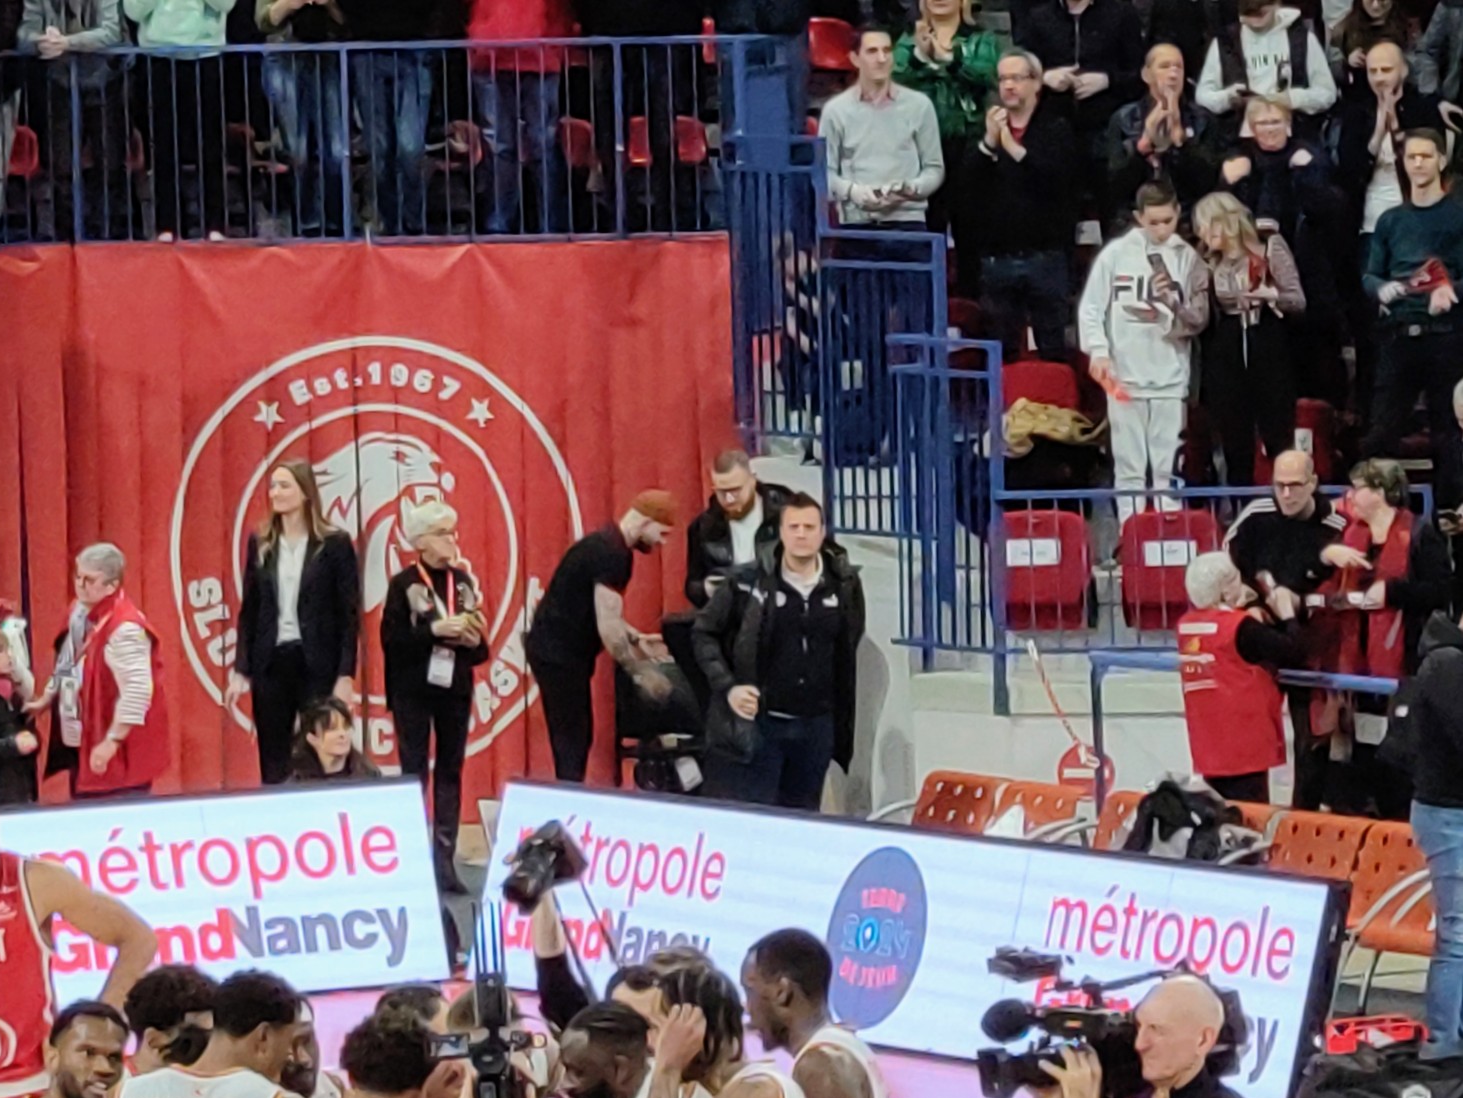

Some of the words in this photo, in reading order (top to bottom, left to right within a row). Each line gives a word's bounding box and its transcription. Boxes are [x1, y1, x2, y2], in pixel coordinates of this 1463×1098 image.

[188, 576, 239, 668] SLU
[520, 814, 725, 907] tropole
[52, 906, 408, 972] GrndNancy
[1045, 884, 1296, 981] métropole
